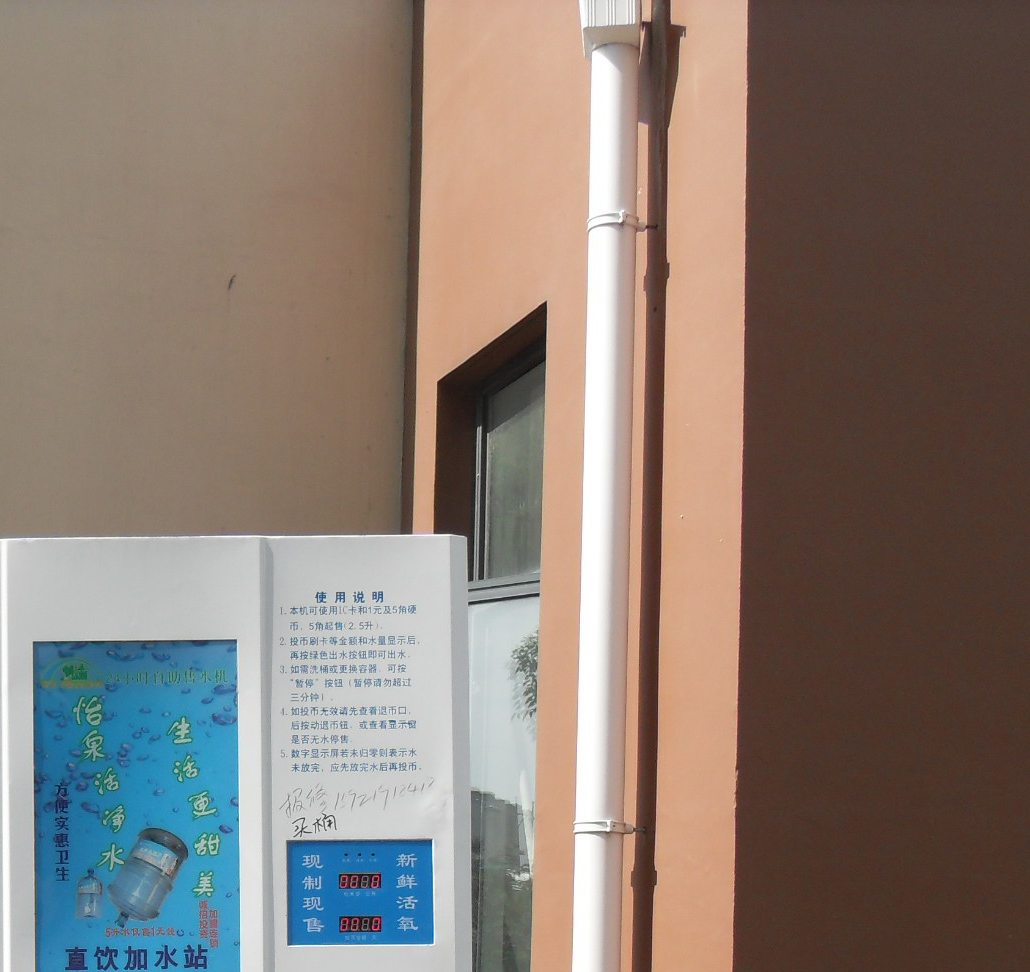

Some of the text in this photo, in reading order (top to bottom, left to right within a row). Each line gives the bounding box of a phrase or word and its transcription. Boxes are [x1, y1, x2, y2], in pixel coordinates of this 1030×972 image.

[315, 591, 384, 604] 使用说明
[54, 782, 70, 881] 方便实惠卫生
[167, 717, 220, 898] 生活更甜美
[302, 854, 324, 933] 现制现售
[396, 853, 418, 932] 新鲜活氧
[65, 944, 208, 970] 直饮加水站
